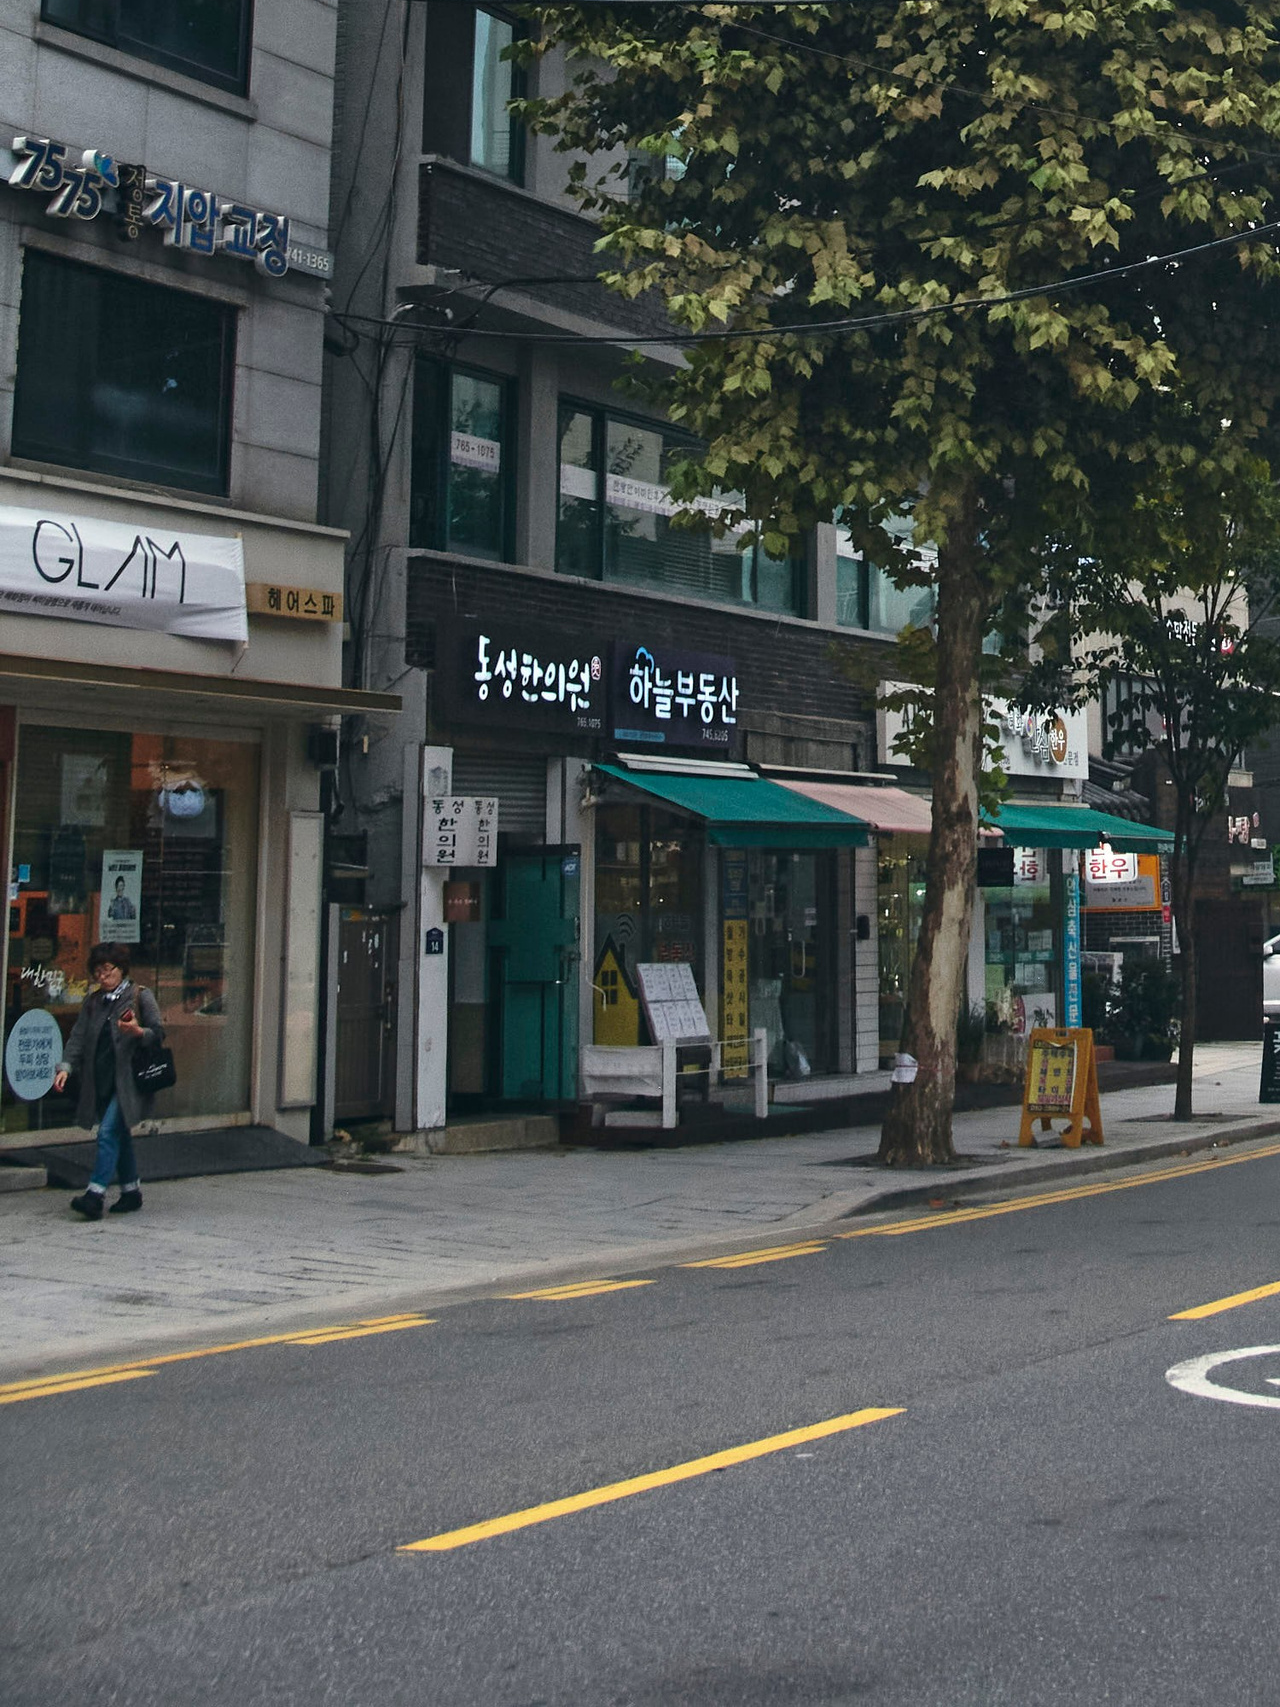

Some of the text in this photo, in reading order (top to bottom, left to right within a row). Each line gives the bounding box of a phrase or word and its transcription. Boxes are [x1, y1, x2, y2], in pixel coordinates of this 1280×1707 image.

[19, 139, 67, 191] 75
[52, 170, 102, 220] 75
[32, 520, 186, 603] GLAM
[266, 587, 336, 617] 헤어스파
[474, 634, 590, 712] 동성한의원
[629, 662, 739, 724] 하늘부동산
[1049, 729, 1065, 751] 한우
[436, 817, 458, 864] 한의원
[477, 819, 490, 864] 한의원
[1089, 858, 1129, 879] 한우
[431, 941, 439, 952] 14
[1066, 877, 1078, 1028] 안심축산물전문
